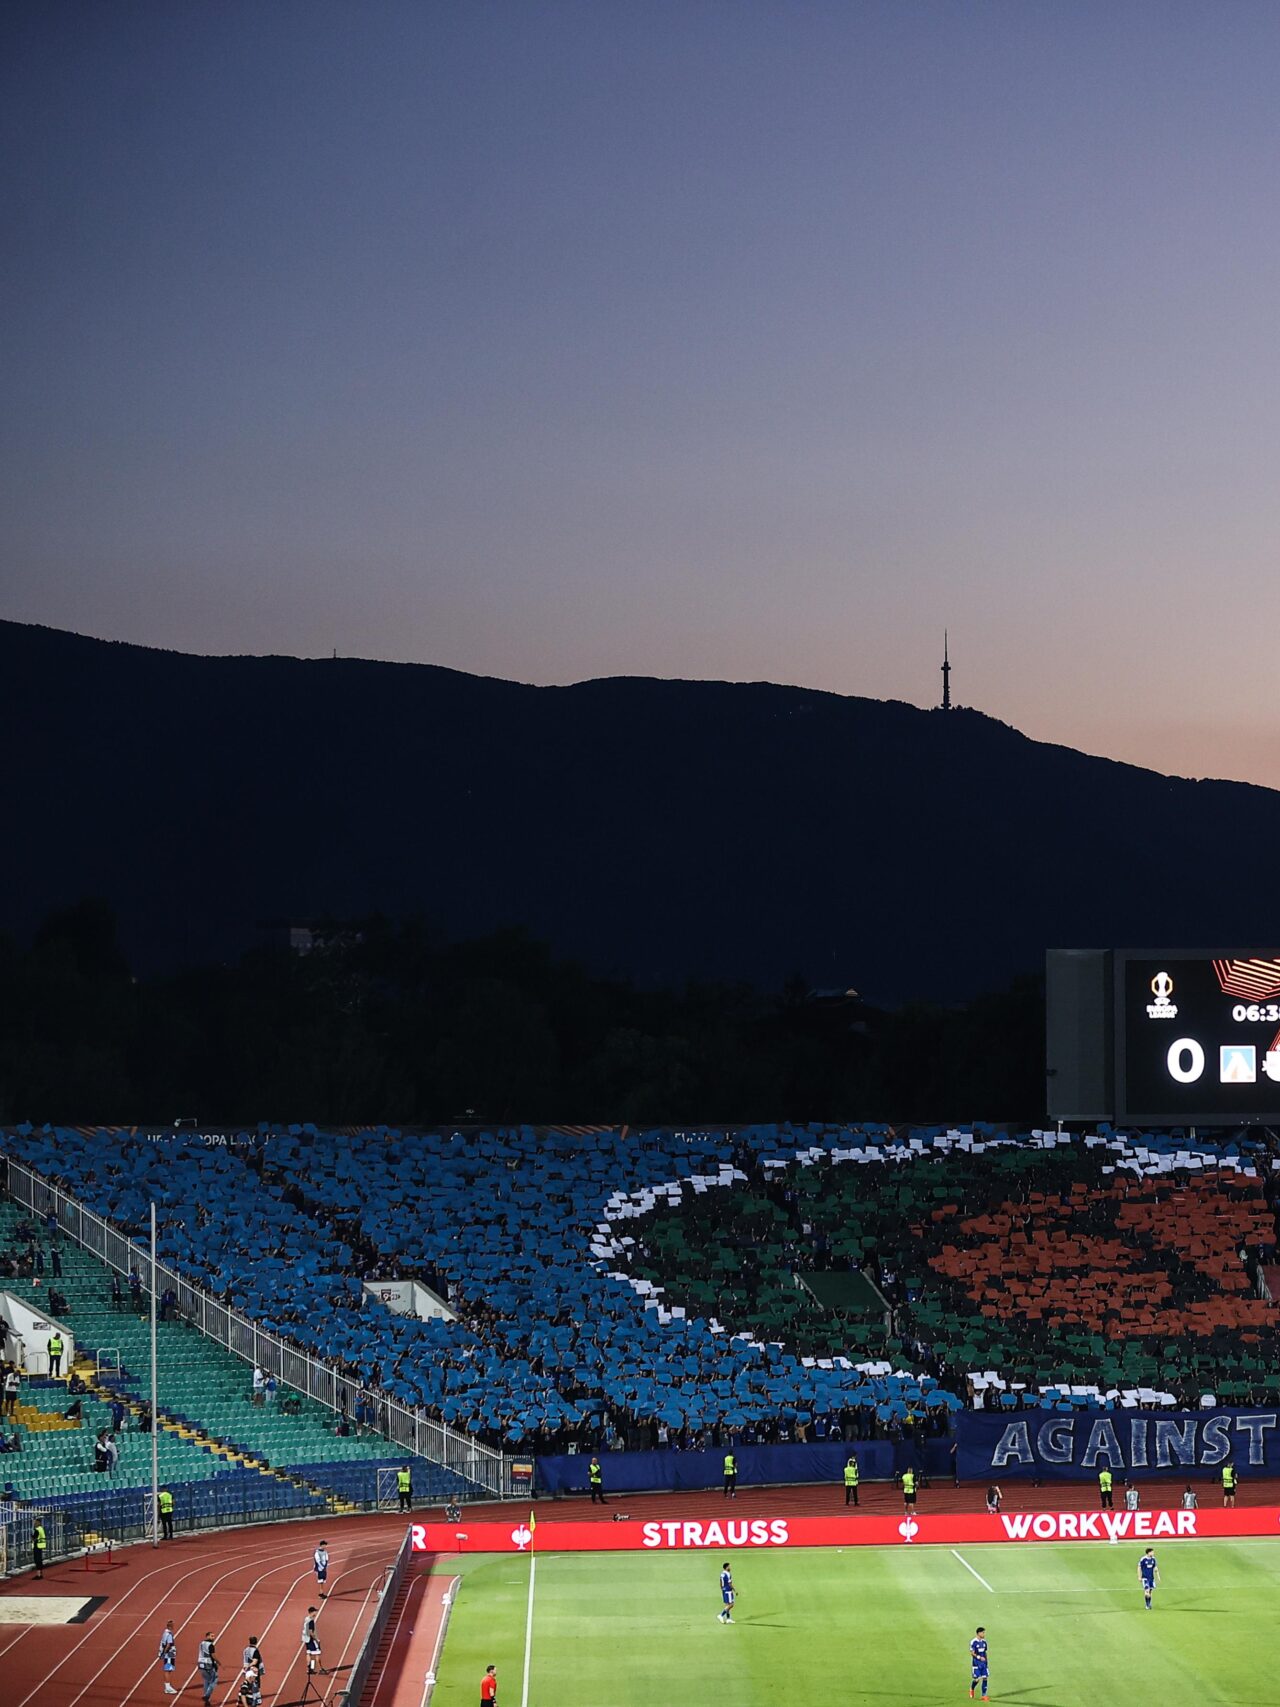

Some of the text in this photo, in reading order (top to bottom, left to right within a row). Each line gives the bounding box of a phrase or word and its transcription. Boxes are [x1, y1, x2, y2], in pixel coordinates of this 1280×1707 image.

[1167, 1037, 1205, 1083] 0
[991, 1414, 1277, 1468] AGAINST
[643, 1519, 789, 1547] STRAUSS
[1001, 1511, 1197, 1539] WORKWEAR
